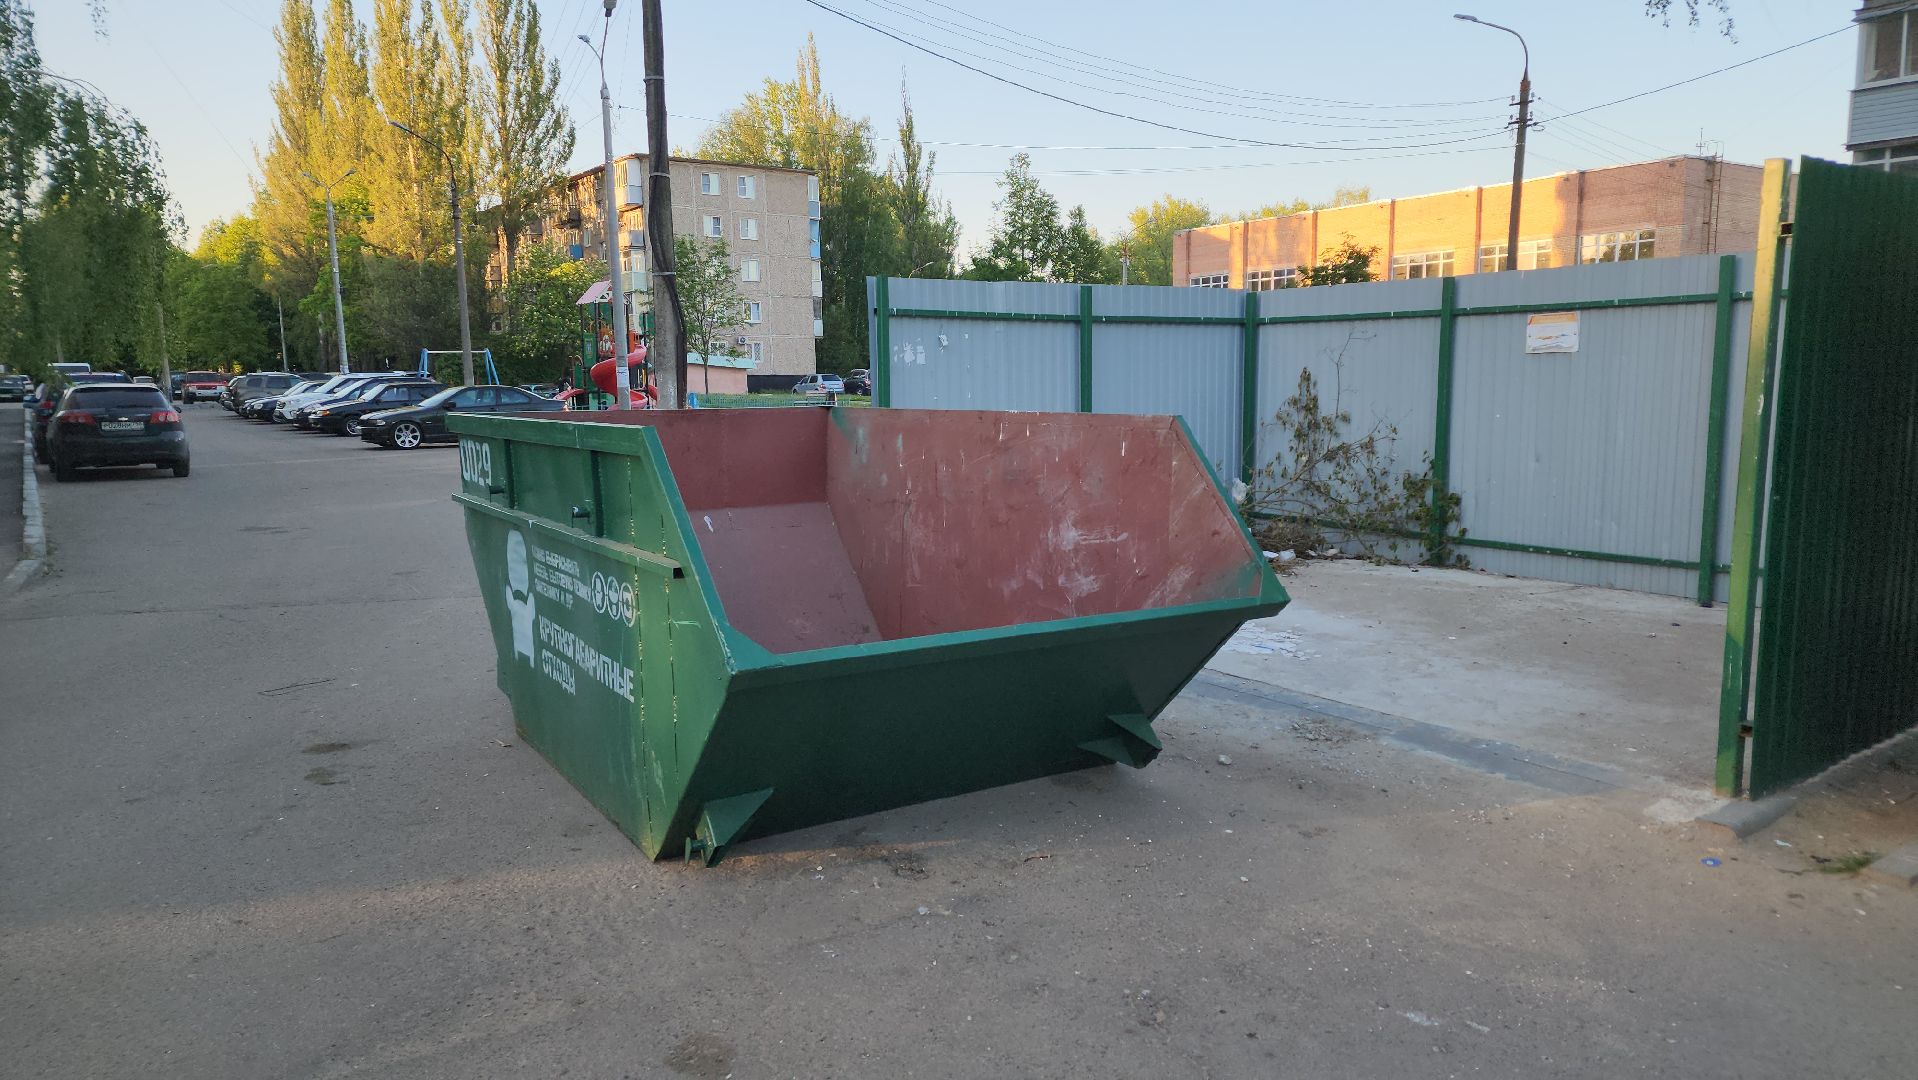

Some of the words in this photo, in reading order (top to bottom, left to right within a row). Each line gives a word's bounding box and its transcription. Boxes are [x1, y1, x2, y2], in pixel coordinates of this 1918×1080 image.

[460, 439, 492, 486] 0029
[538, 614, 635, 703] КРУПНОГАБАРИТНЫЕ
[542, 648, 576, 696] ОТХОДЫ
